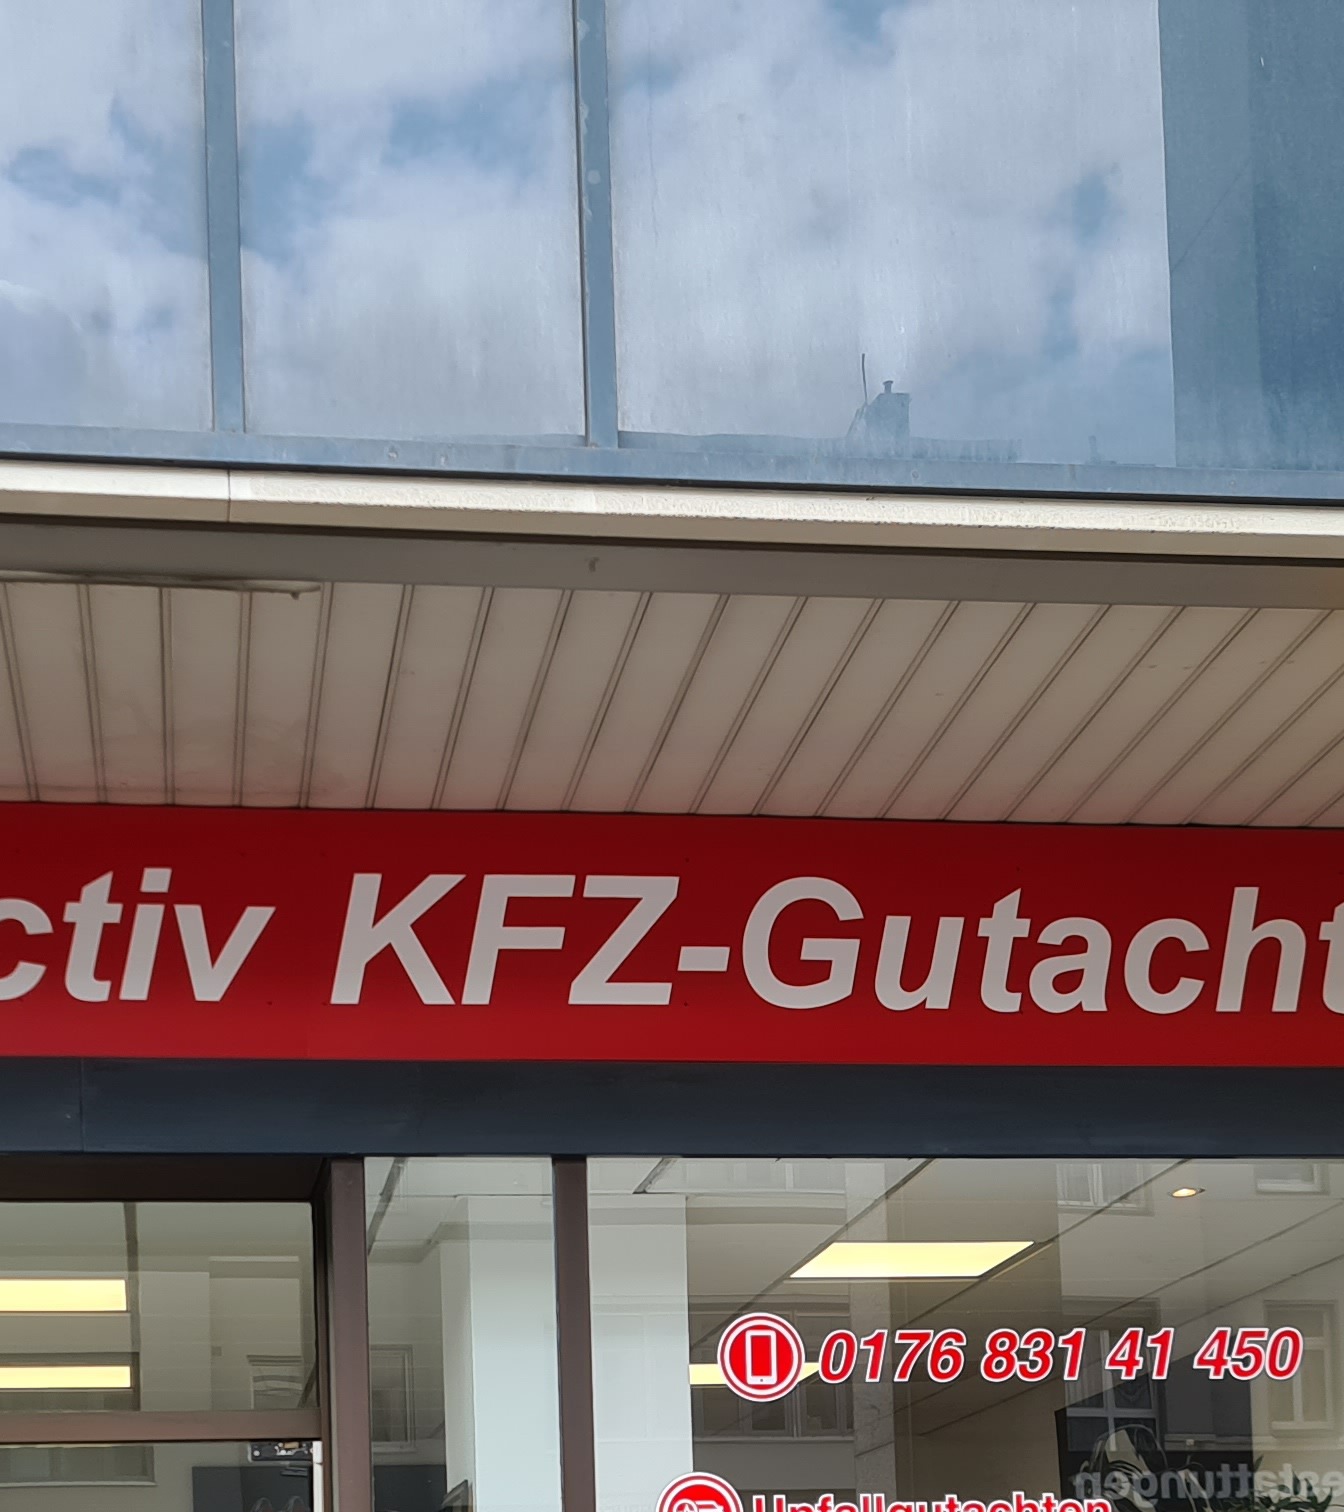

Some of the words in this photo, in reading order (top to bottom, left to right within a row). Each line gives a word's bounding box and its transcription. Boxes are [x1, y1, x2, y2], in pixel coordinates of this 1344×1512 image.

[819, 1329, 966, 1383] 0176
[981, 1328, 1086, 1381] 831
[1106, 1328, 1174, 1380] 41
[1194, 1328, 1303, 1380] 450
